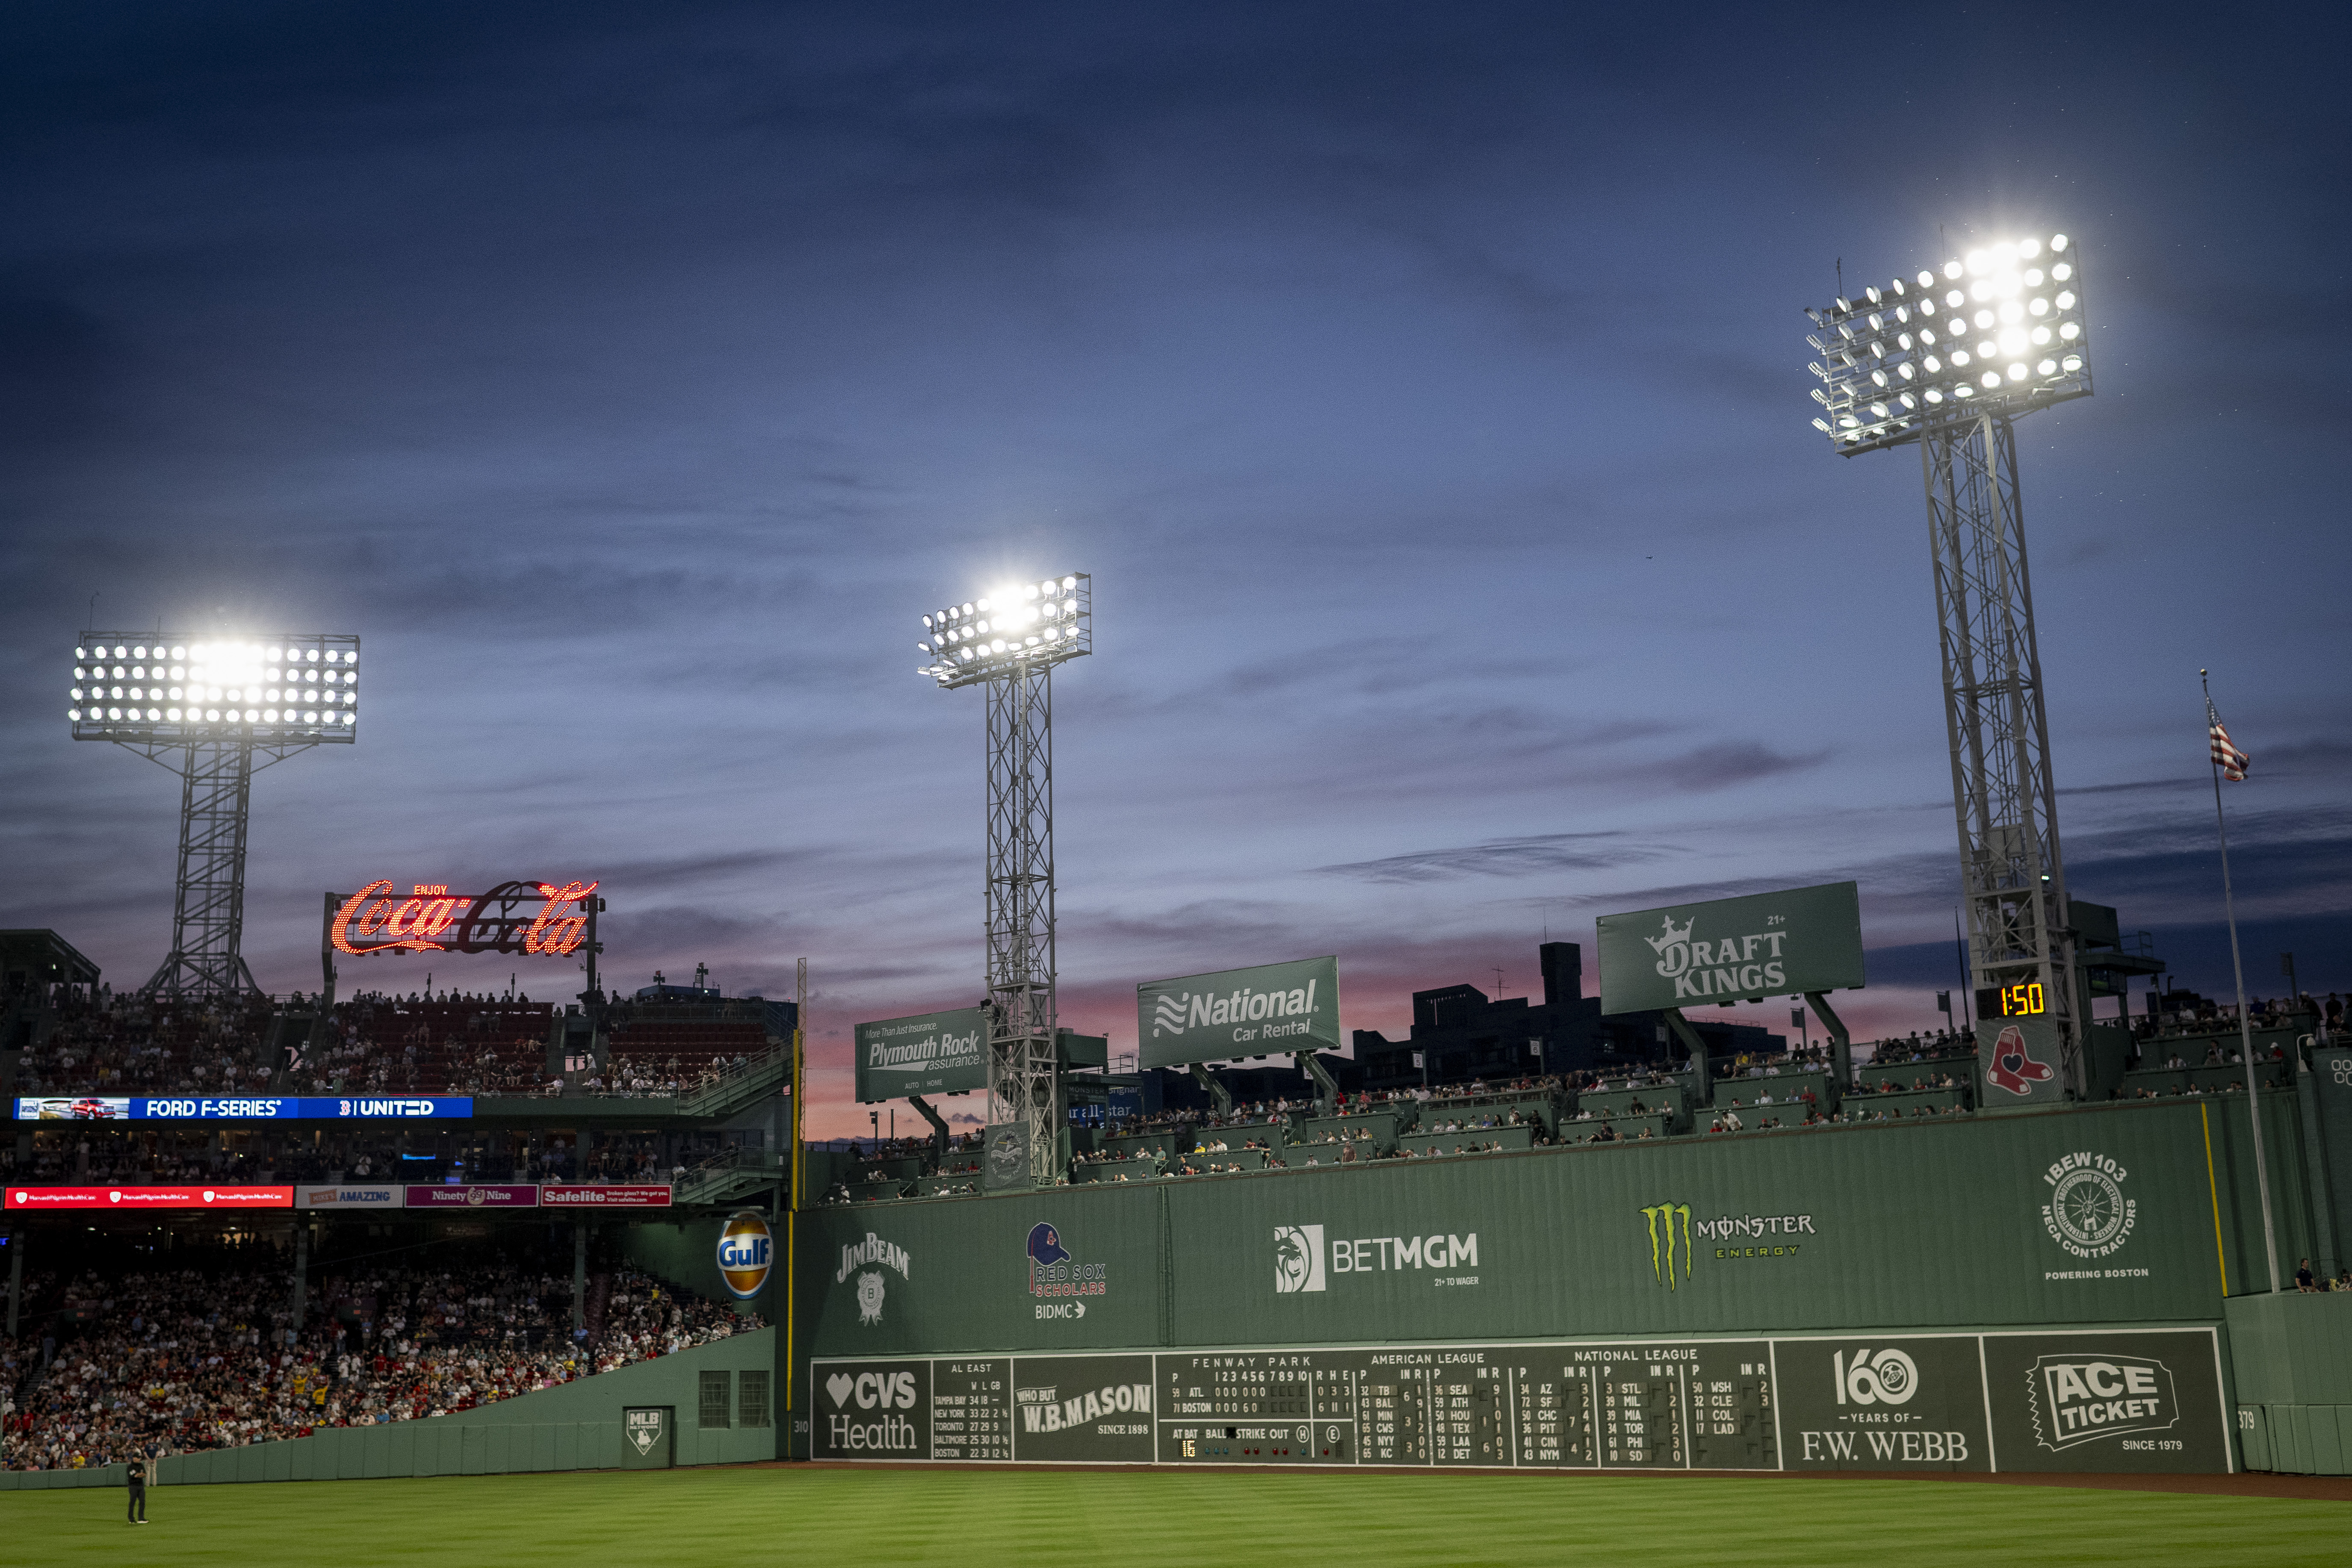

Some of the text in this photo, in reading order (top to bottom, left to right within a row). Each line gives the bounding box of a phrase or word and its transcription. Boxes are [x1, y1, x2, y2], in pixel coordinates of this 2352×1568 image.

[414, 885, 447, 895] ENJOY
[1768, 915, 1786, 926] 21+
[1656, 931, 1786, 977] DRAFT
[1675, 961, 1786, 998] KINGS
[2001, 983, 2044, 1016] 1:50
[865, 1023, 937, 1039] More Than Just Insurance.
[1233, 1019, 1310, 1042] Car Rental
[869, 1031, 979, 1066] Plymouth Rock
[929, 1055, 979, 1070] assurance
[147, 1101, 195, 1116] FORD
[360, 1101, 434, 1115] UNITED
[2043, 1152, 2127, 1186] IBEW 103
[2092, 1175, 2101, 1184] OF
[339, 1192, 390, 1202] AMAZING
[432, 1190, 511, 1202] Ninety Nine
[544, 1191, 605, 1202] Safelite
[1696, 1214, 1816, 1240] MONSTER
[2042, 1199, 2136, 1258] NECA CONTRACTORS
[719, 1238, 769, 1267] Gulf
[1333, 1233, 1478, 1273] BETMGM
[1716, 1246, 1798, 1258] ENERGY
[837, 1232, 909, 1283] JIM BEAM
[1036, 1264, 1106, 1282] RED SOX
[2045, 1268, 2149, 1280] POWERING BOSTON
[1434, 1277, 1479, 1286] 21+ TO WAGER
[1036, 1282, 1106, 1297] SCHOLARS
[1036, 1304, 1073, 1319] BIDMC
[1371, 1353, 1484, 1364] AMERICAN LEAGUE
[1575, 1349, 1697, 1361] NATIONAL LEAGUE
[1193, 1357, 1310, 1367] FENWAY PARK
[967, 1364, 991, 1372] EAST
[1834, 1348, 1918, 1405] 160
[972, 1381, 1000, 1390] W L GB
[1711, 1382, 1731, 1392] WSH
[2057, 1362, 2158, 1403] ACE
[855, 1372, 916, 1409] CVS
[1172, 1388, 1204, 1397] 59 ATL
[1378, 1386, 1389, 1395] TB
[1450, 1385, 1468, 1395] SEA
[1540, 1384, 1552, 1394] AZ
[1622, 1383, 1641, 1394] STL
[935, 1396, 988, 1405] TAMPA BAY 34 18
[1016, 1389, 1056, 1403] WHO BUT
[1624, 1396, 1641, 1406] MIL
[1711, 1396, 1733, 1406] CLE
[1376, 1398, 1393, 1408] BAL
[1451, 1398, 1468, 1408] ATH
[1540, 1397, 1552, 1407] SF
[1173, 1403, 1211, 1413] 71 BOSTON
[629, 1412, 659, 1425] MLB
[935, 1409, 989, 1418] NEW YORK 33 22
[1377, 1411, 1393, 1420] MIN
[1451, 1411, 1470, 1420] HOU
[1538, 1410, 1557, 1420] CHC
[1625, 1410, 1641, 1420] MIA
[1712, 1410, 1734, 1420] COL
[1851, 1413, 1909, 1423] YEARS OF
[2061, 1398, 2160, 1429] TICKET
[2238, 1411, 2254, 1429] 379
[795, 1420, 808, 1433] 310
[935, 1422, 989, 1431] TORONTO 27 29
[1098, 1425, 1149, 1434] SINCE 1898
[1377, 1423, 1394, 1433] CWS
[1452, 1423, 1470, 1433] TEX
[1540, 1423, 1555, 1433] PIT
[1625, 1423, 1644, 1434] TOR
[1714, 1423, 1734, 1434] LAD
[829, 1414, 917, 1450] Health
[1173, 1429, 1336, 1439] AT BAT BALL STRIKE OUT H E
[935, 1435, 990, 1444] BALTIMORE 25 30
[1378, 1436, 1394, 1446] NYY
[1453, 1436, 1470, 1447] LAA
[1541, 1437, 1557, 1447] CIN
[1627, 1437, 1642, 1447] PHI
[1183, 1441, 1195, 1457] 16
[1800, 1432, 1968, 1461] F.W. WEBB
[2122, 1441, 2182, 1450] SINCE 1979
[935, 1449, 989, 1458] BOSTON 22 31
[1381, 1449, 1393, 1459] KC
[1454, 1449, 1470, 1459] DET
[1540, 1450, 1559, 1460] NYM
[1629, 1450, 1642, 1461] SD
